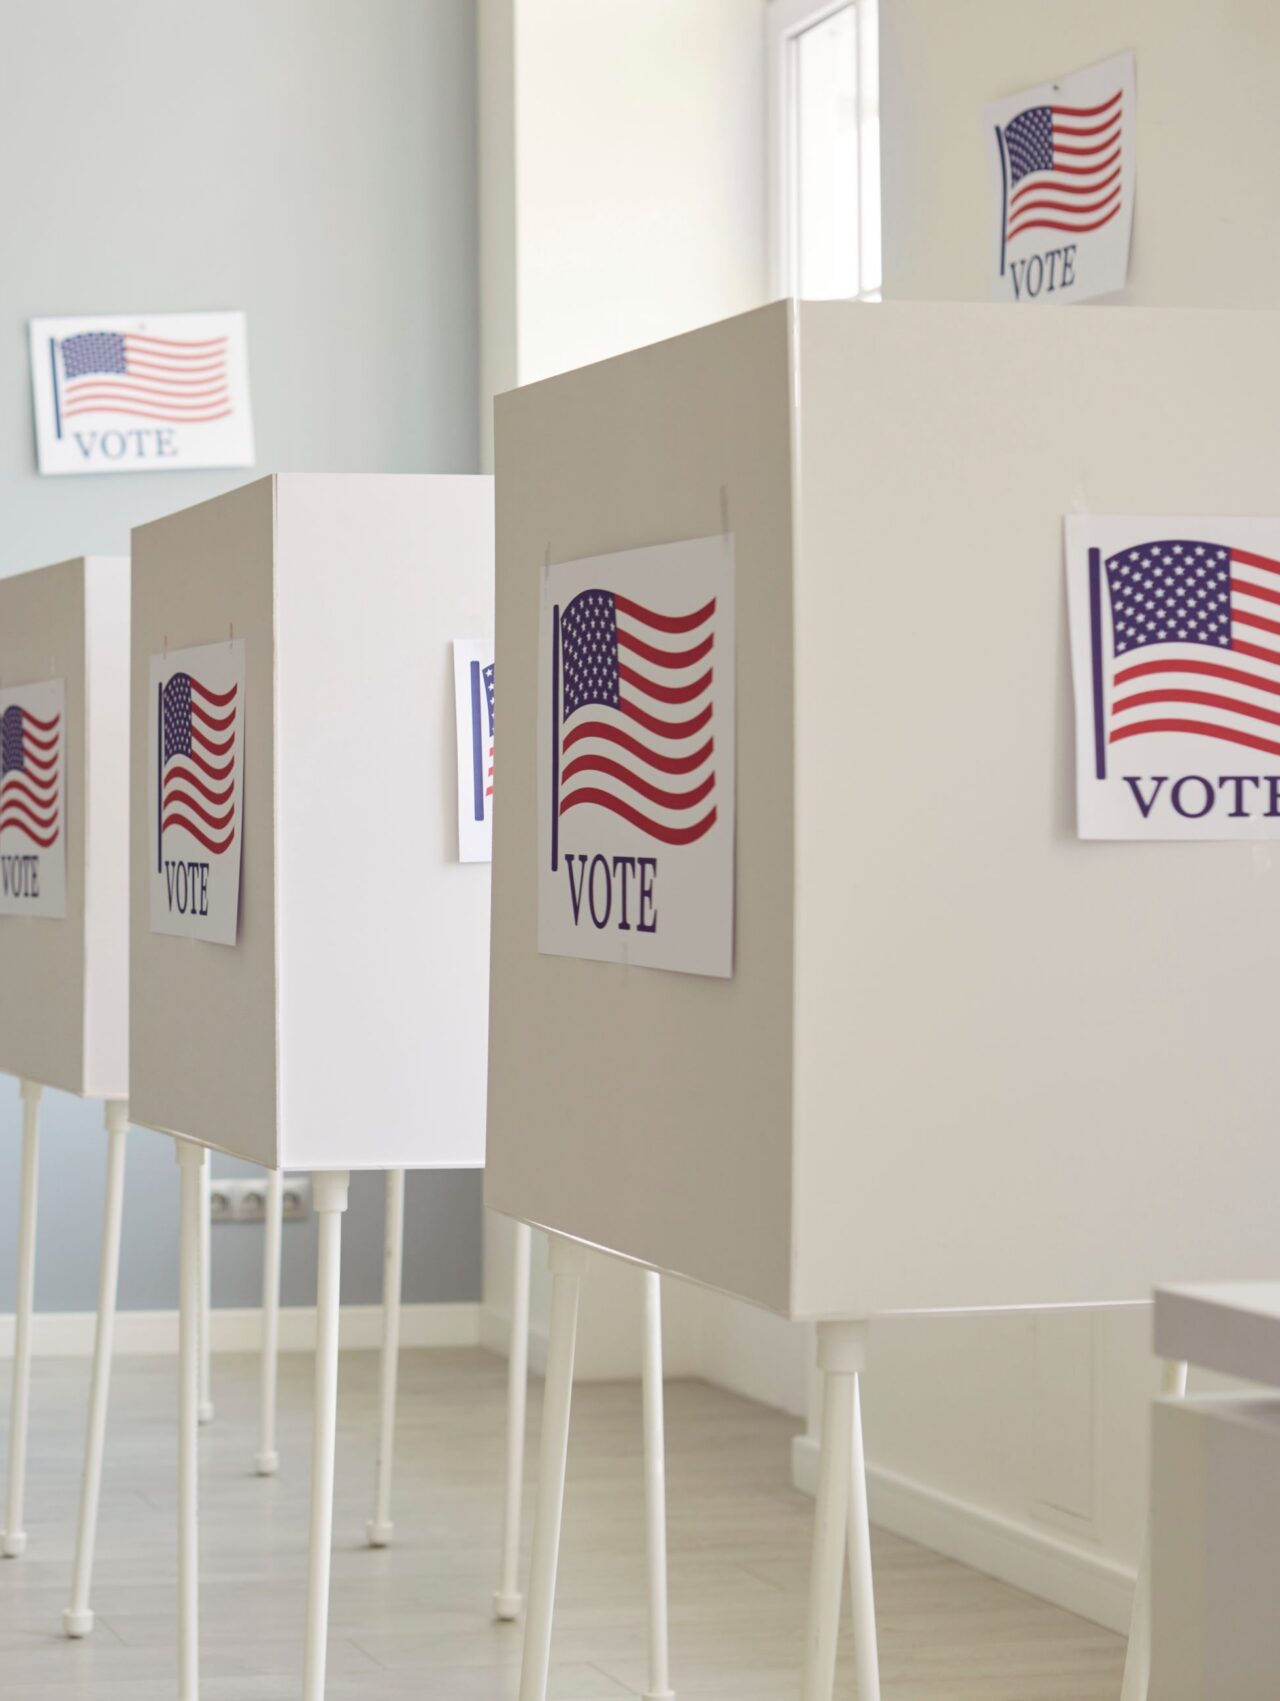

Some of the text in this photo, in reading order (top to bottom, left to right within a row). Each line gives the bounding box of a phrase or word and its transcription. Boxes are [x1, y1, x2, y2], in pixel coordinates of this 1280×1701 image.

[1010, 244, 1077, 300] VOTE
[74, 429, 178, 459] VOTE
[1, 855, 39, 898] VOTE
[165, 860, 209, 916] VOTE
[565, 853, 657, 933] VOTE
